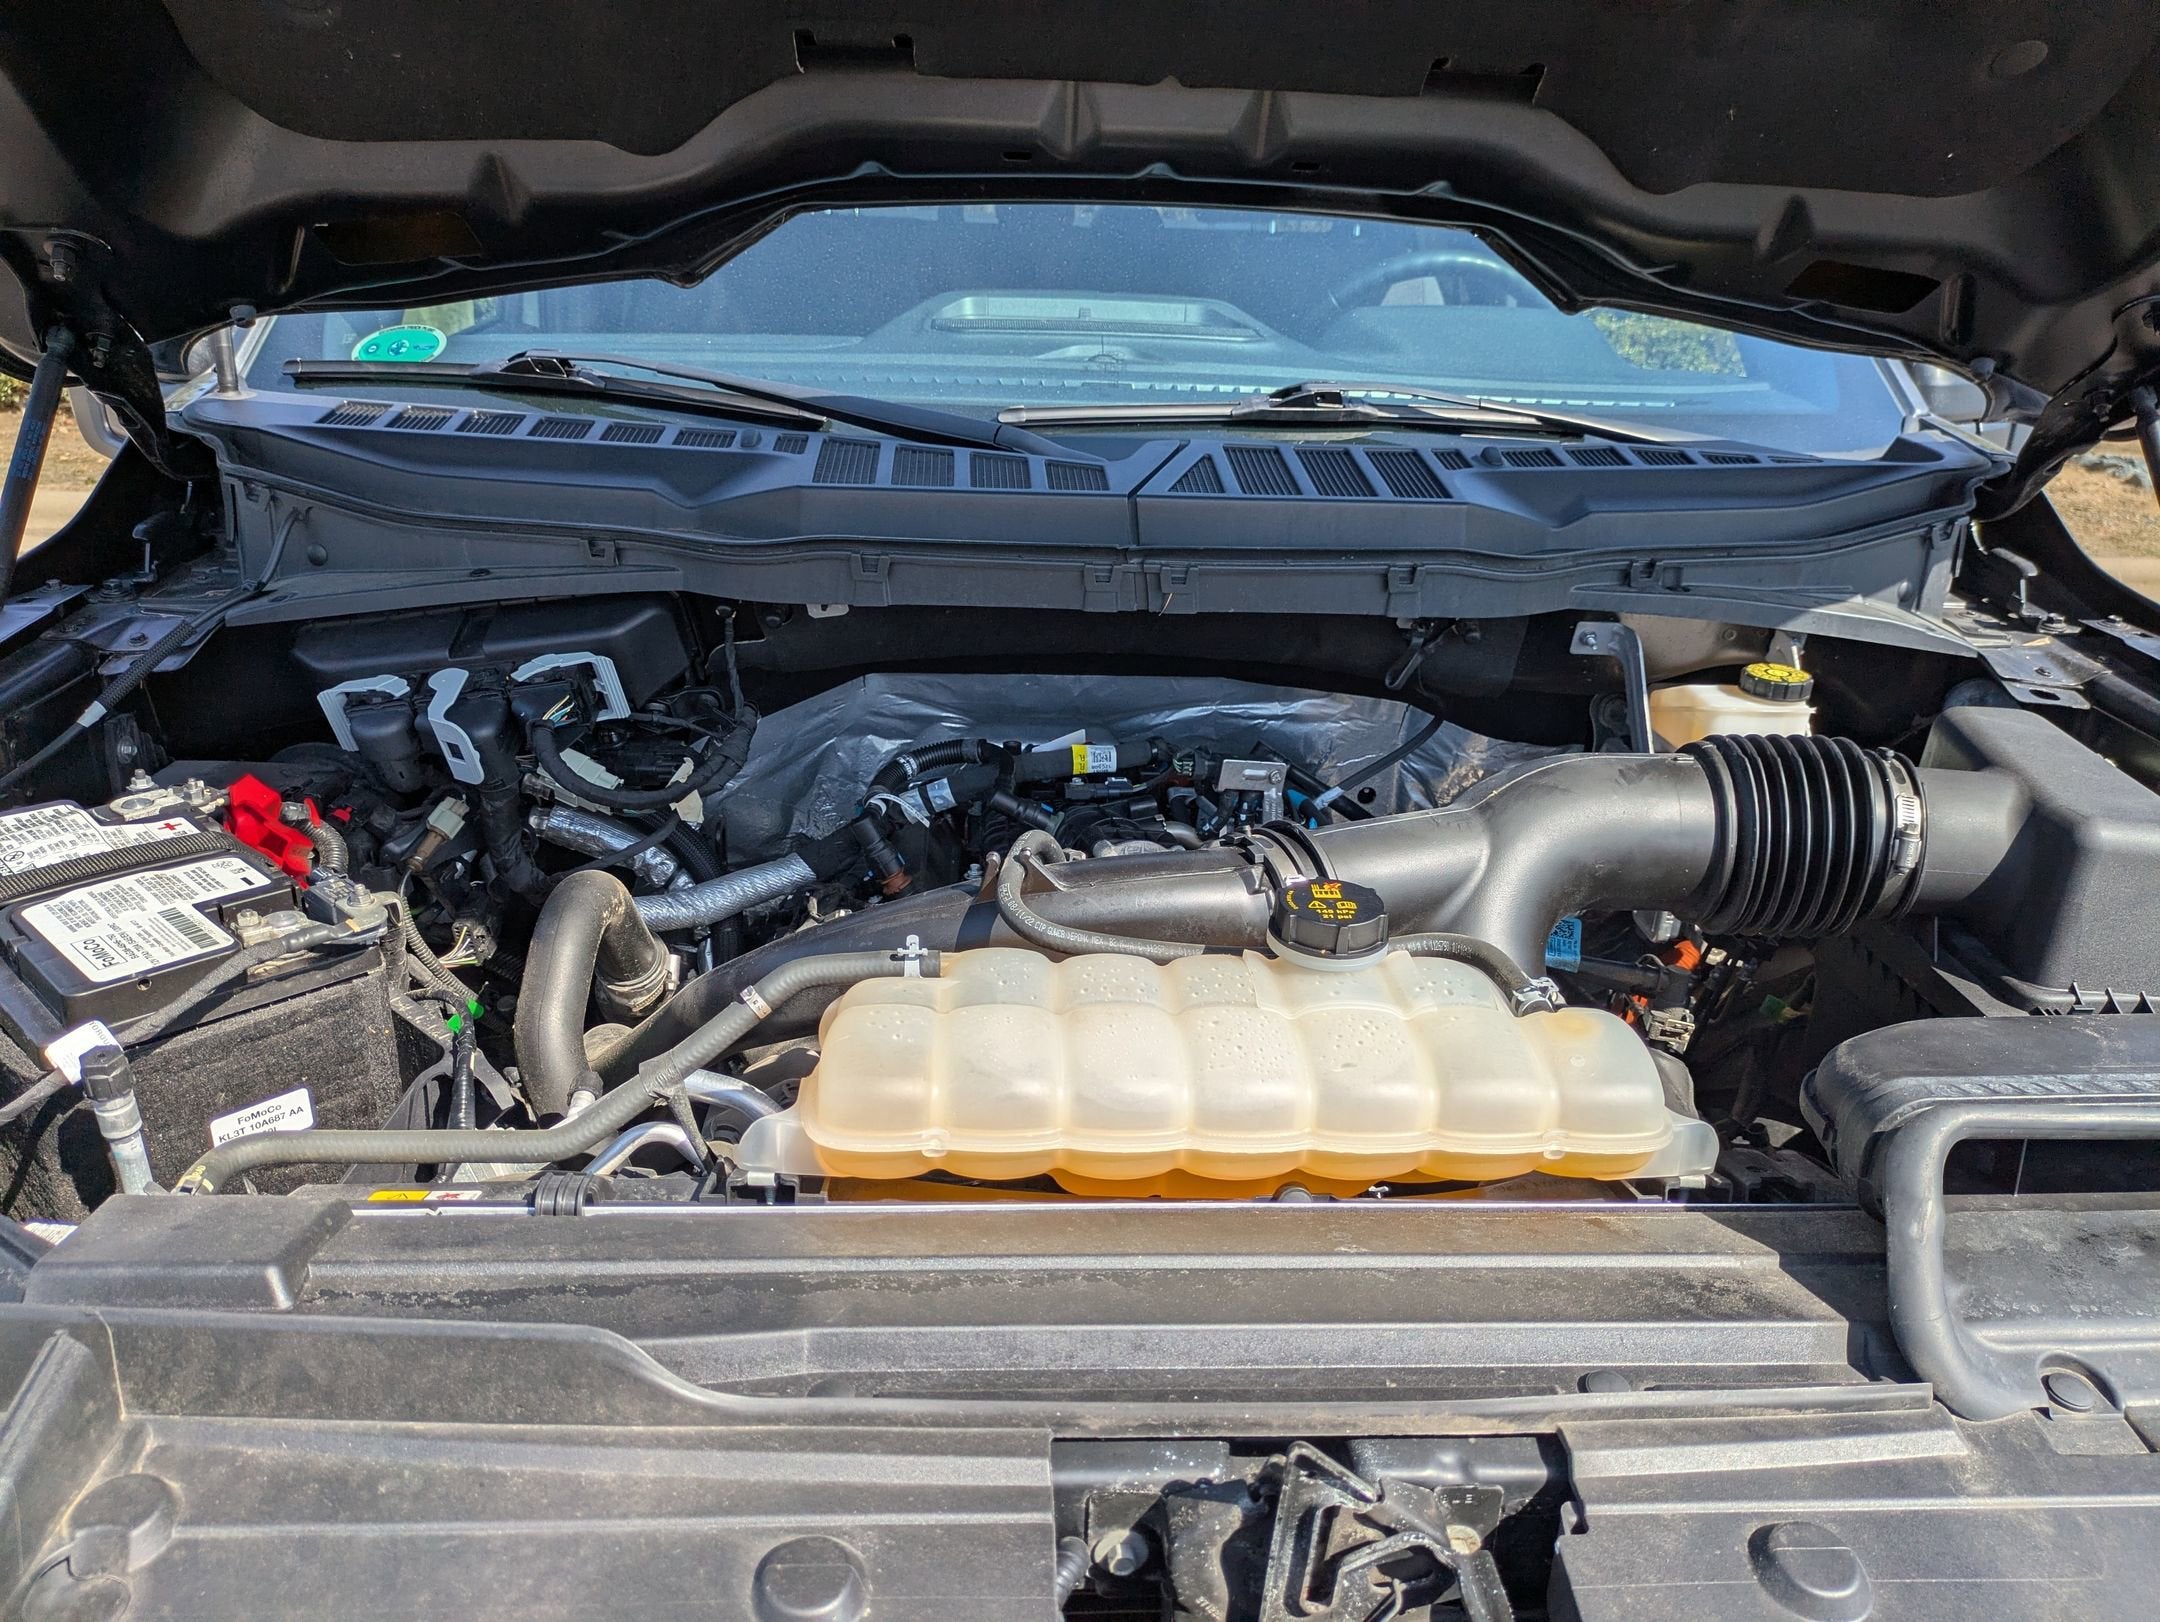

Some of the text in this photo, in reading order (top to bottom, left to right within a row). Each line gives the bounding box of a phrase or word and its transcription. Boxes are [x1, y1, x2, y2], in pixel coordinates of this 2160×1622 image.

[83, 938, 119, 968] FoMoCo
[89, 1021, 110, 1045] TORQU
[218, 1106, 304, 1143] KL3T 10A687 AA
[237, 1105, 282, 1125] FoMoCo
